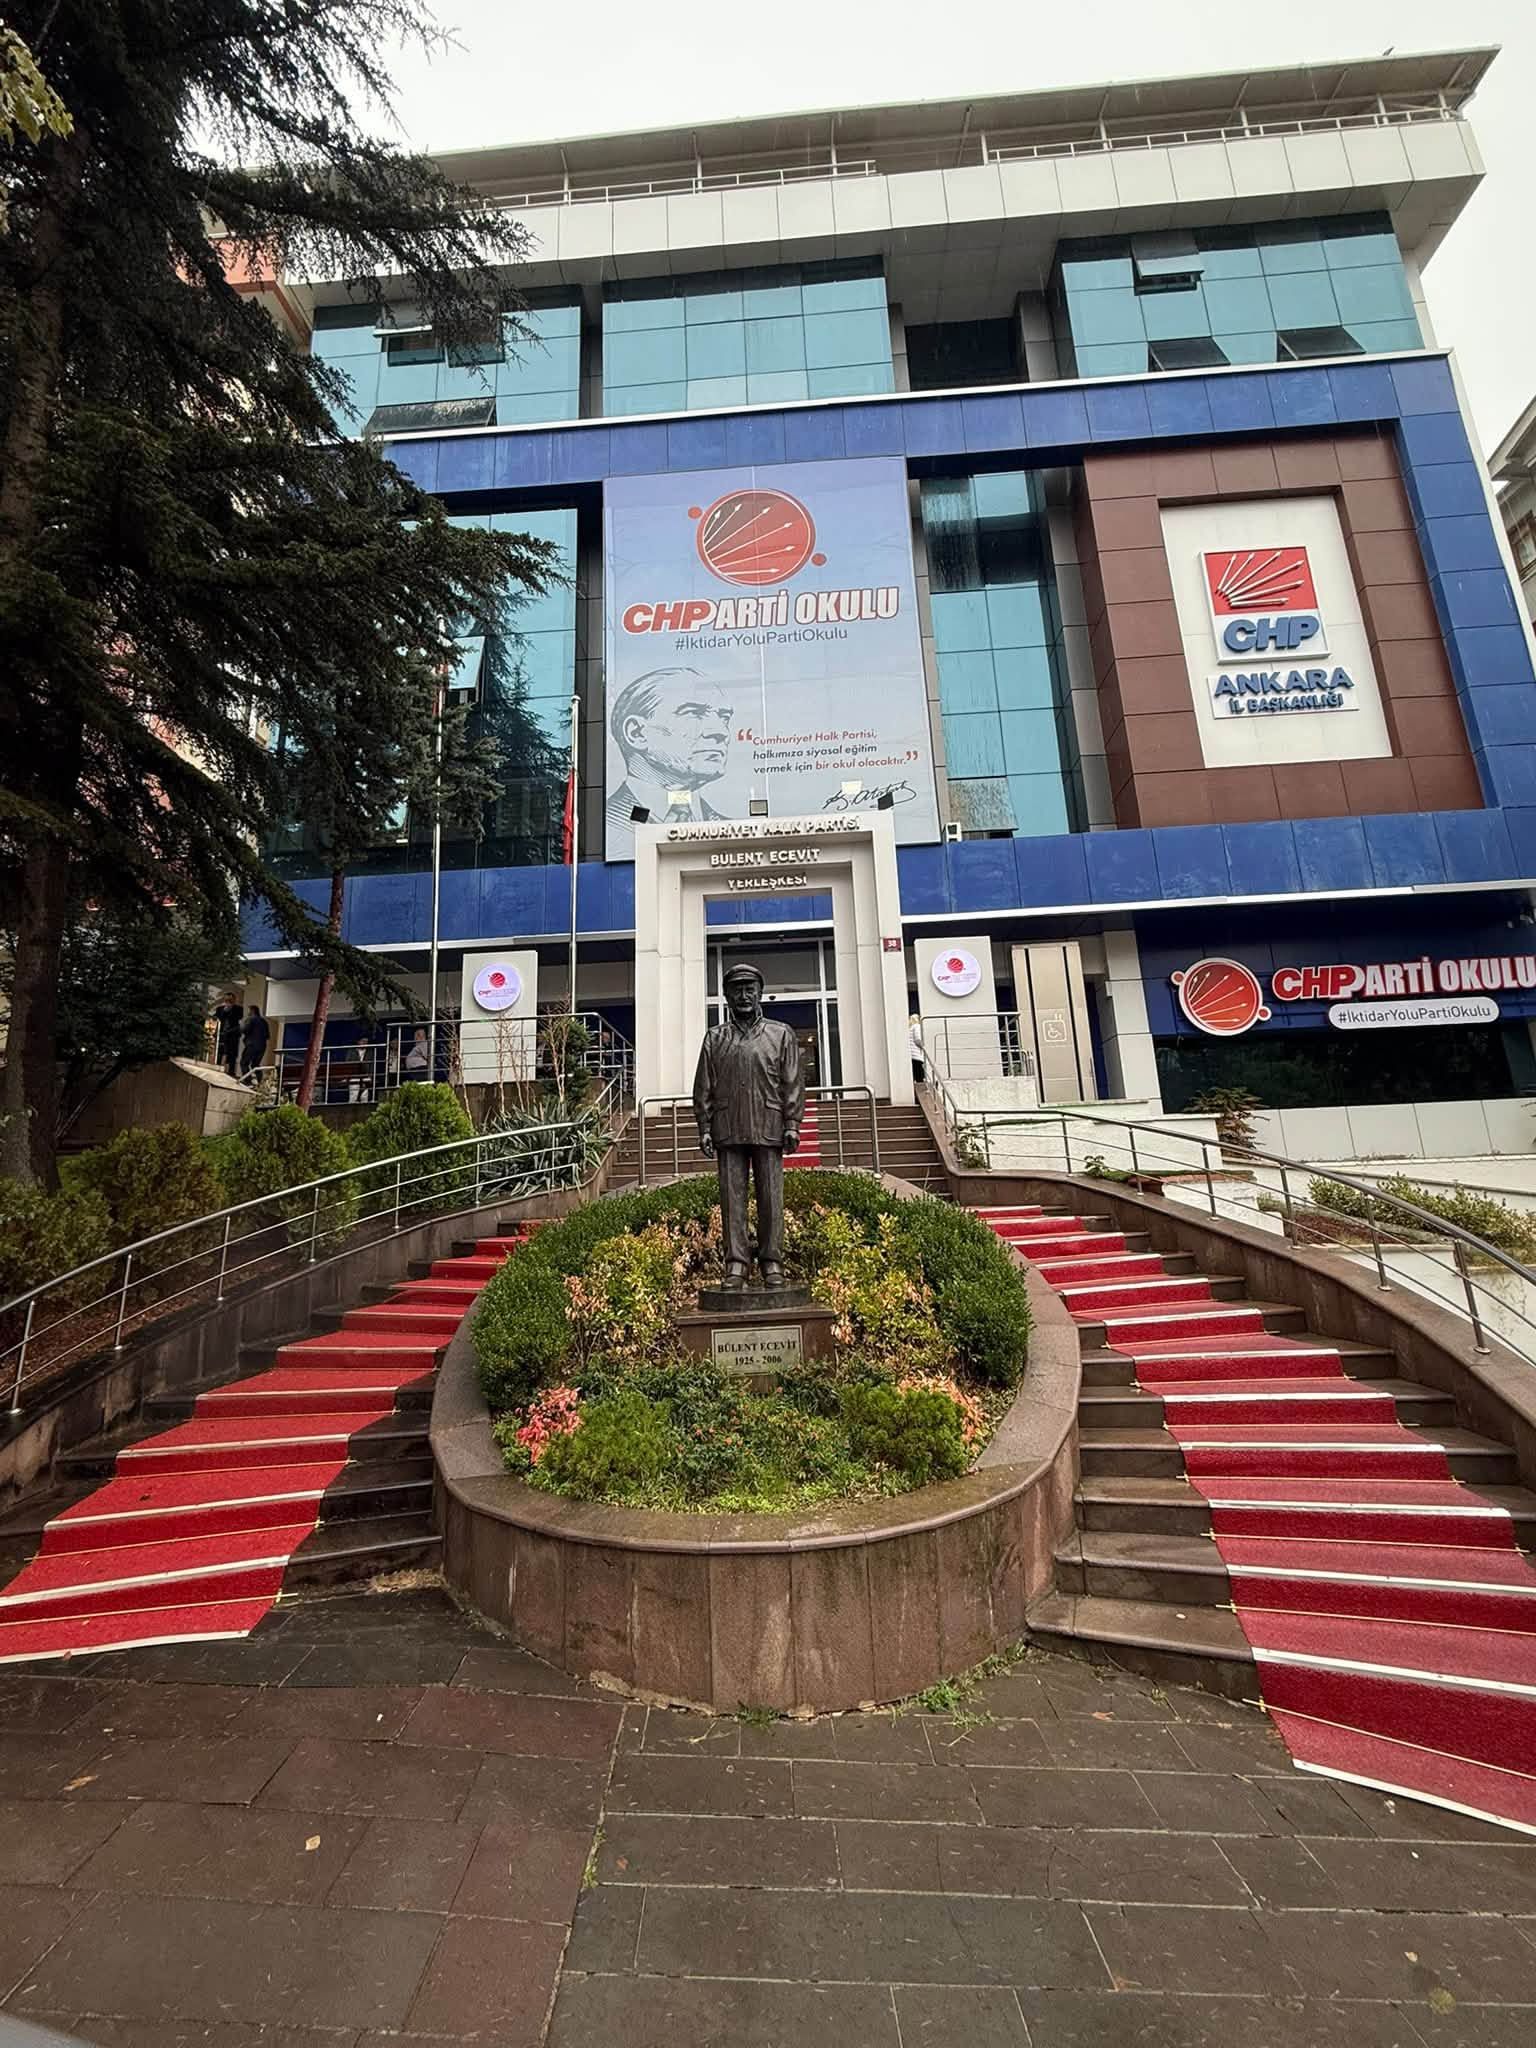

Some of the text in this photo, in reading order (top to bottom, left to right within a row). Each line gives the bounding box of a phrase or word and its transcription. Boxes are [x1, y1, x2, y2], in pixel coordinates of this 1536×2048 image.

[793, 586, 901, 624] OKULU
[1224, 615, 1320, 654] CHP
[1214, 667, 1355, 698] ANKARA
[1228, 691, 1345, 715] İL BAŞKANLIĞI
[815, 732, 839, 742] Halk
[806, 745, 842, 758] siyasal
[845, 744, 877, 755] eğitim
[753, 762, 792, 774] vermek
[795, 761, 813, 773] için
[815, 759, 829, 770] bir
[832, 759, 856, 769] okul
[668, 823, 758, 841] CUMHURİYET
[769, 847, 820, 864] ECEVİT
[1438, 956, 1536, 991] OKULU
[718, 1339, 797, 1353] BÜLENT ECEVİT
